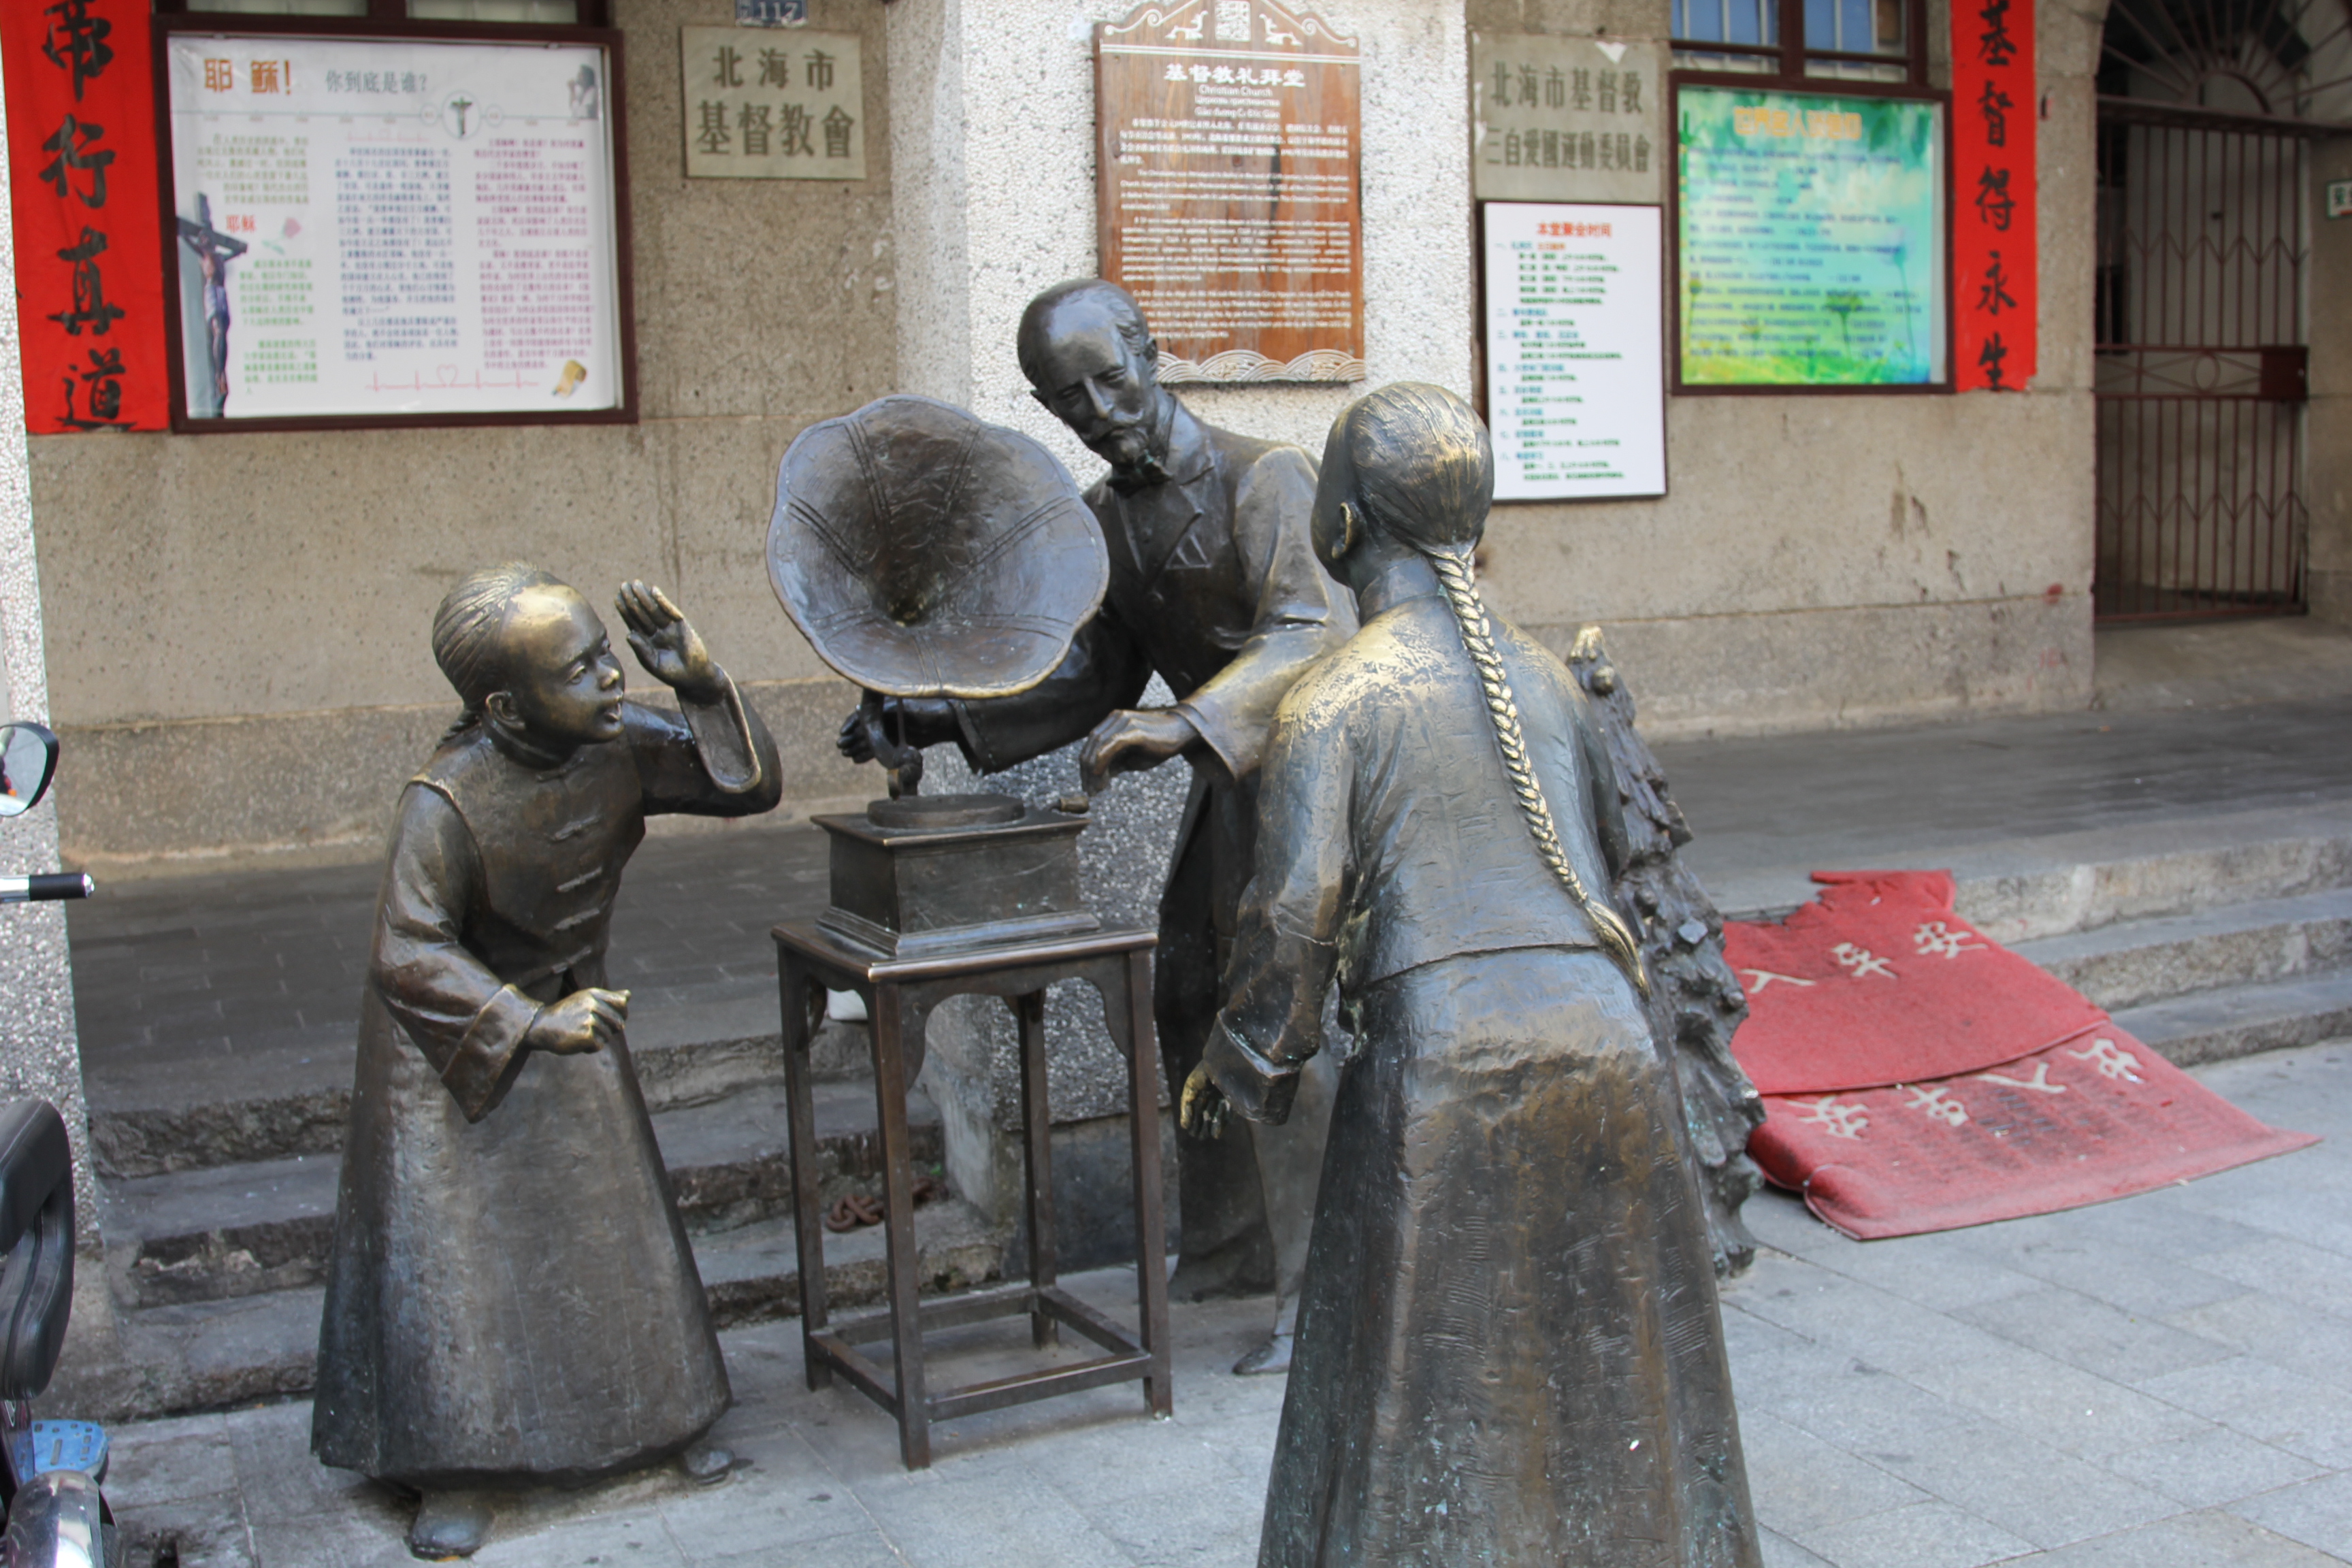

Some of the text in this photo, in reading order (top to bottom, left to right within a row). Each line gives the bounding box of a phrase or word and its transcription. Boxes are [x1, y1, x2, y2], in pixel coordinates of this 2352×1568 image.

[757, 1, 798, 21] 117
[713, 46, 835, 91] 北海市
[1163, 63, 1306, 88] 基督教礼拜堂
[1198, 84, 1273, 97] Christian Church
[1490, 61, 1643, 114] 北海市基督教
[697, 100, 854, 158] 基督教會
